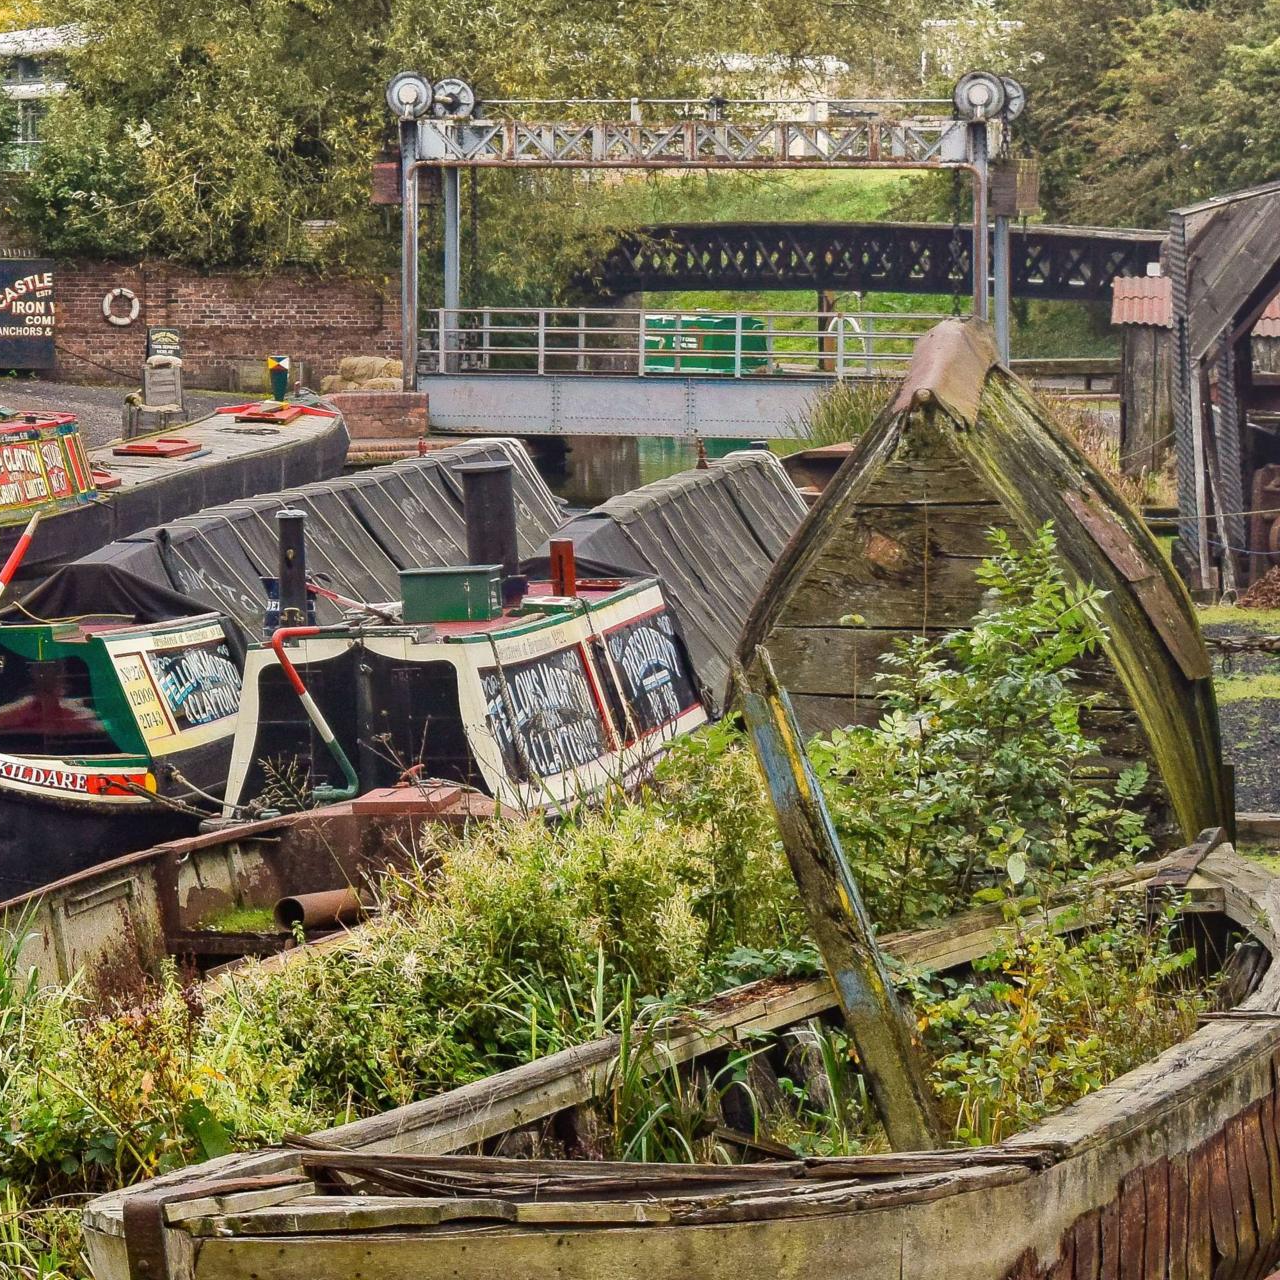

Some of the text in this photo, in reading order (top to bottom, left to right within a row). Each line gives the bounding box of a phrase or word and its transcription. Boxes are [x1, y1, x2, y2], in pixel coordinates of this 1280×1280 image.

[12, 301, 45, 314] IRON
[44, 326, 53, 336] &
[3, 448, 43, 476] CLAYTON
[622, 626, 682, 698] PRESIDENT
[129, 687, 155, 707] 12009
[538, 663, 597, 720] MORTON
[139, 710, 164, 730] 21743
